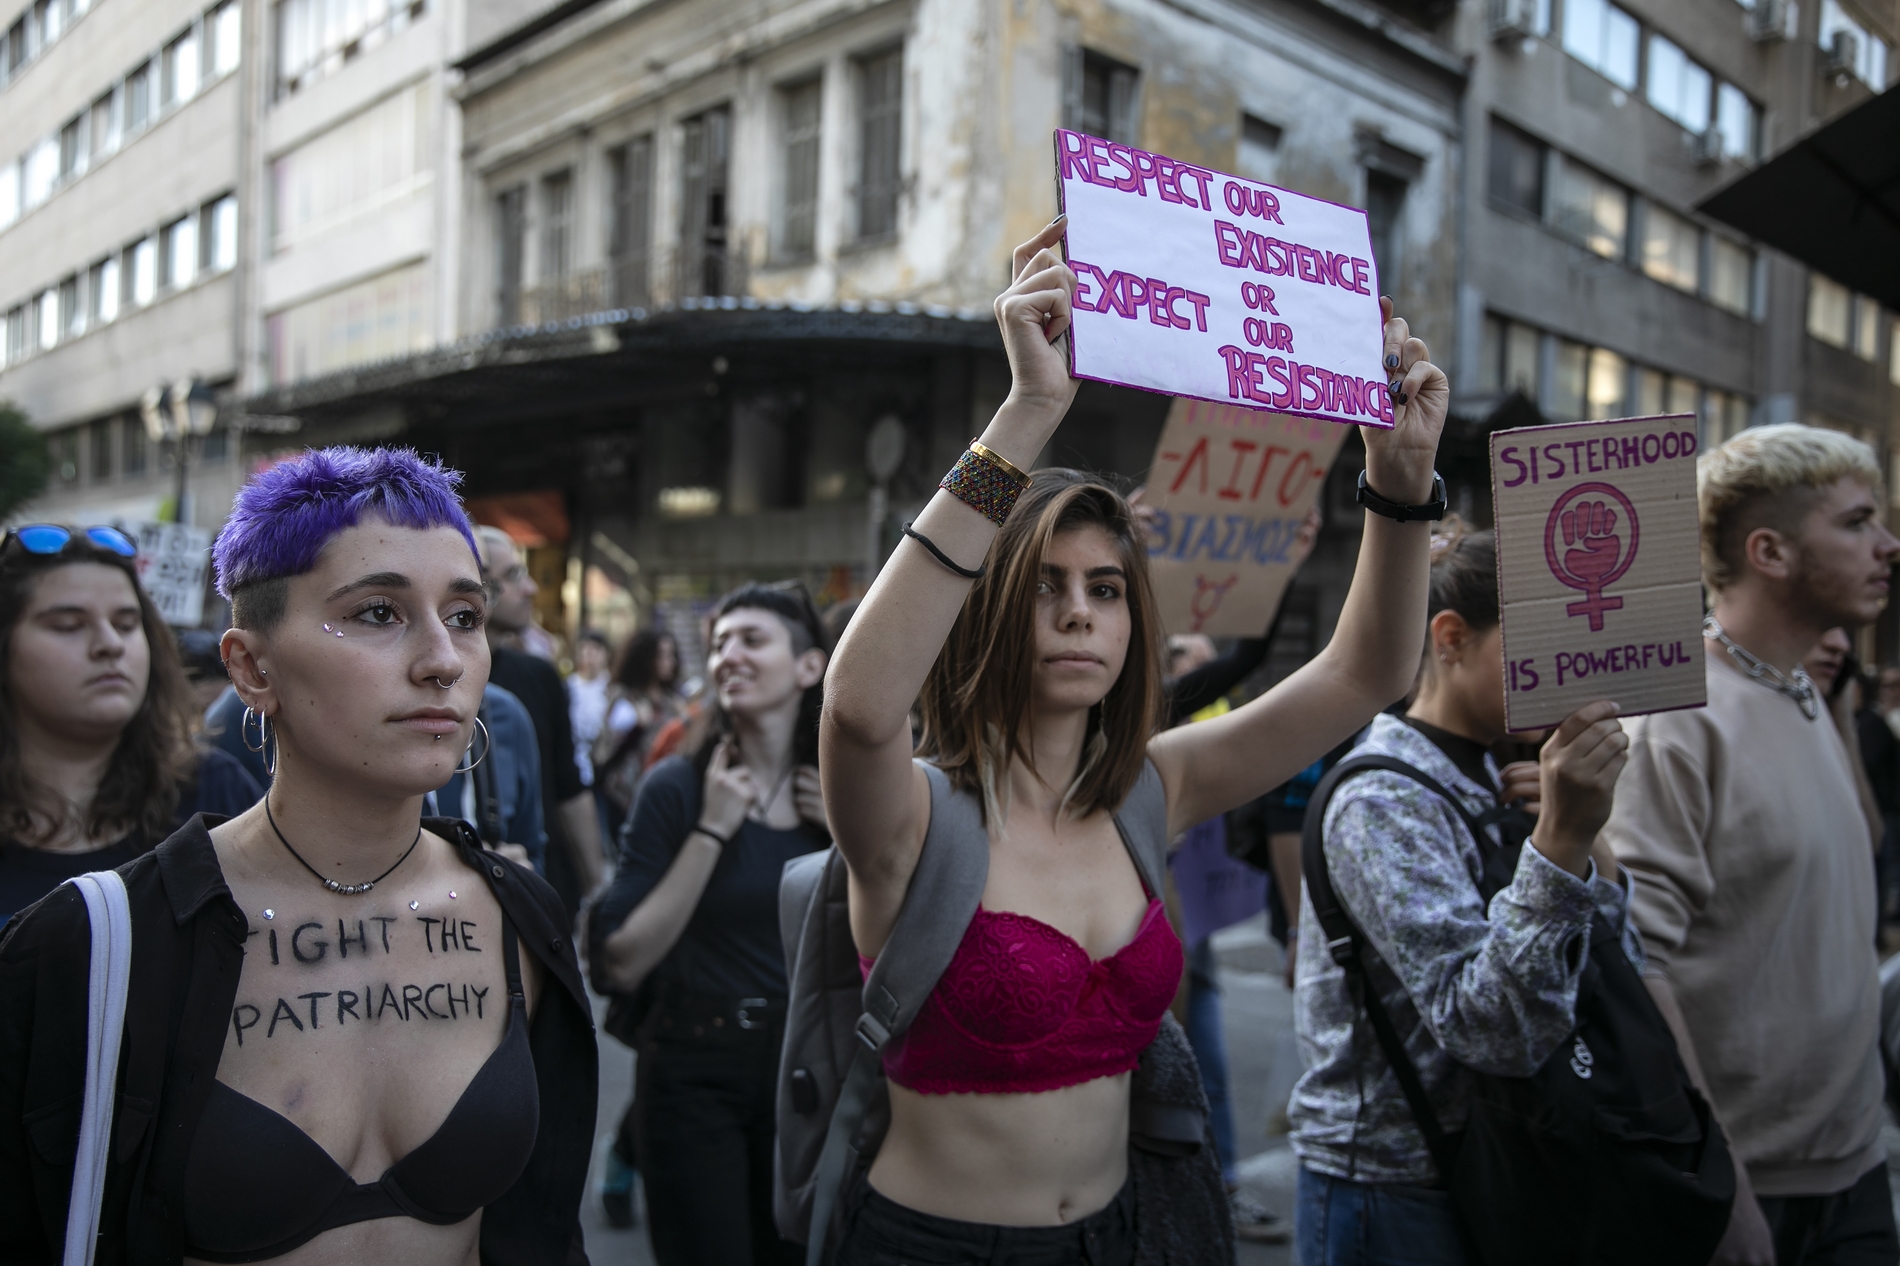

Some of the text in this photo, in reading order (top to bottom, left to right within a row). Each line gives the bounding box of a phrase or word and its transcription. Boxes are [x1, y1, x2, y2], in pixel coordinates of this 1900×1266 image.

[1058, 133, 1284, 225] RESPECT OUR
[1214, 219, 1371, 297] EXISTENCE
[1069, 260, 1211, 332] EXPECT
[1241, 281, 1279, 316] OR
[1243, 316, 1294, 353] OUR
[1218, 344, 1394, 423] RESISTANCE
[1500, 432, 1697, 488] SISTERHOOD
[1509, 641, 1691, 692] IS POWERFUL
[246, 916, 482, 966] IGHT THE
[233, 983, 489, 1049] PATRIARCHY
